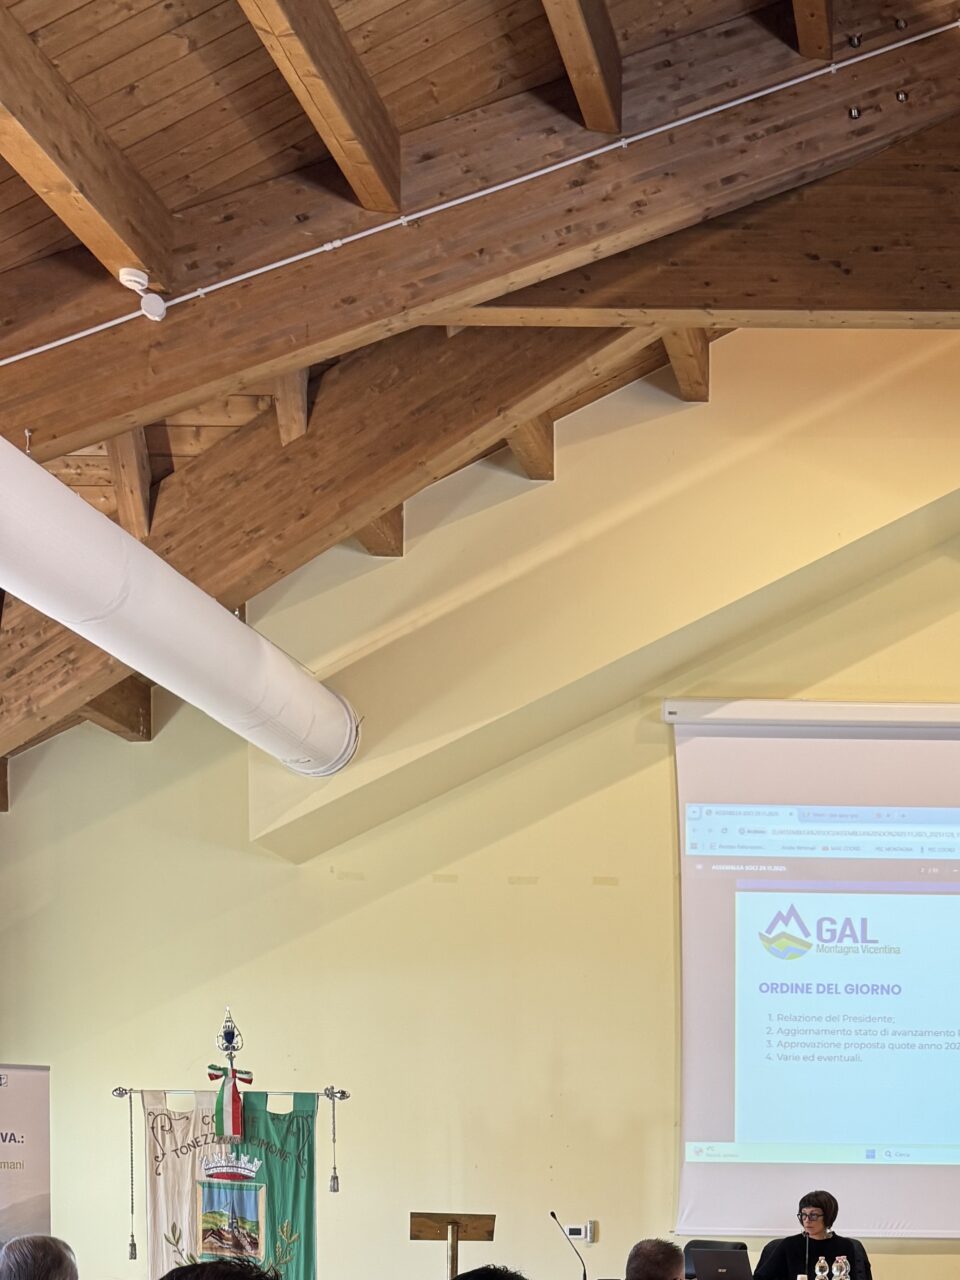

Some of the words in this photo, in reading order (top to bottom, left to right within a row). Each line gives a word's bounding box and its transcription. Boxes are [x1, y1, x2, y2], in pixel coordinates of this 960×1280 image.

[817, 917, 879, 943] GAL
[817, 944, 859, 956] Montagna
[862, 945, 901, 954] Vicentina
[759, 983, 812, 994] ORDINE
[816, 984, 841, 994] DEL
[844, 984, 902, 995] GIORNO
[777, 1014, 823, 1022] Relazione
[825, 1014, 840, 1023] del
[843, 1015, 896, 1024] Presidente;
[777, 1027, 852, 1036] Aggiornamento
[854, 1028, 878, 1036] stato
[880, 1028, 888, 1036] di
[891, 1029, 955, 1037] avanzamento
[777, 1041, 841, 1050] Approvazione
[844, 1042, 886, 1050] proposta
[888, 1042, 915, 1050] quote
[777, 1054, 799, 1062] Varie
[802, 1054, 814, 1062] ed
[250, 1135, 292, 1160] CIMONE
